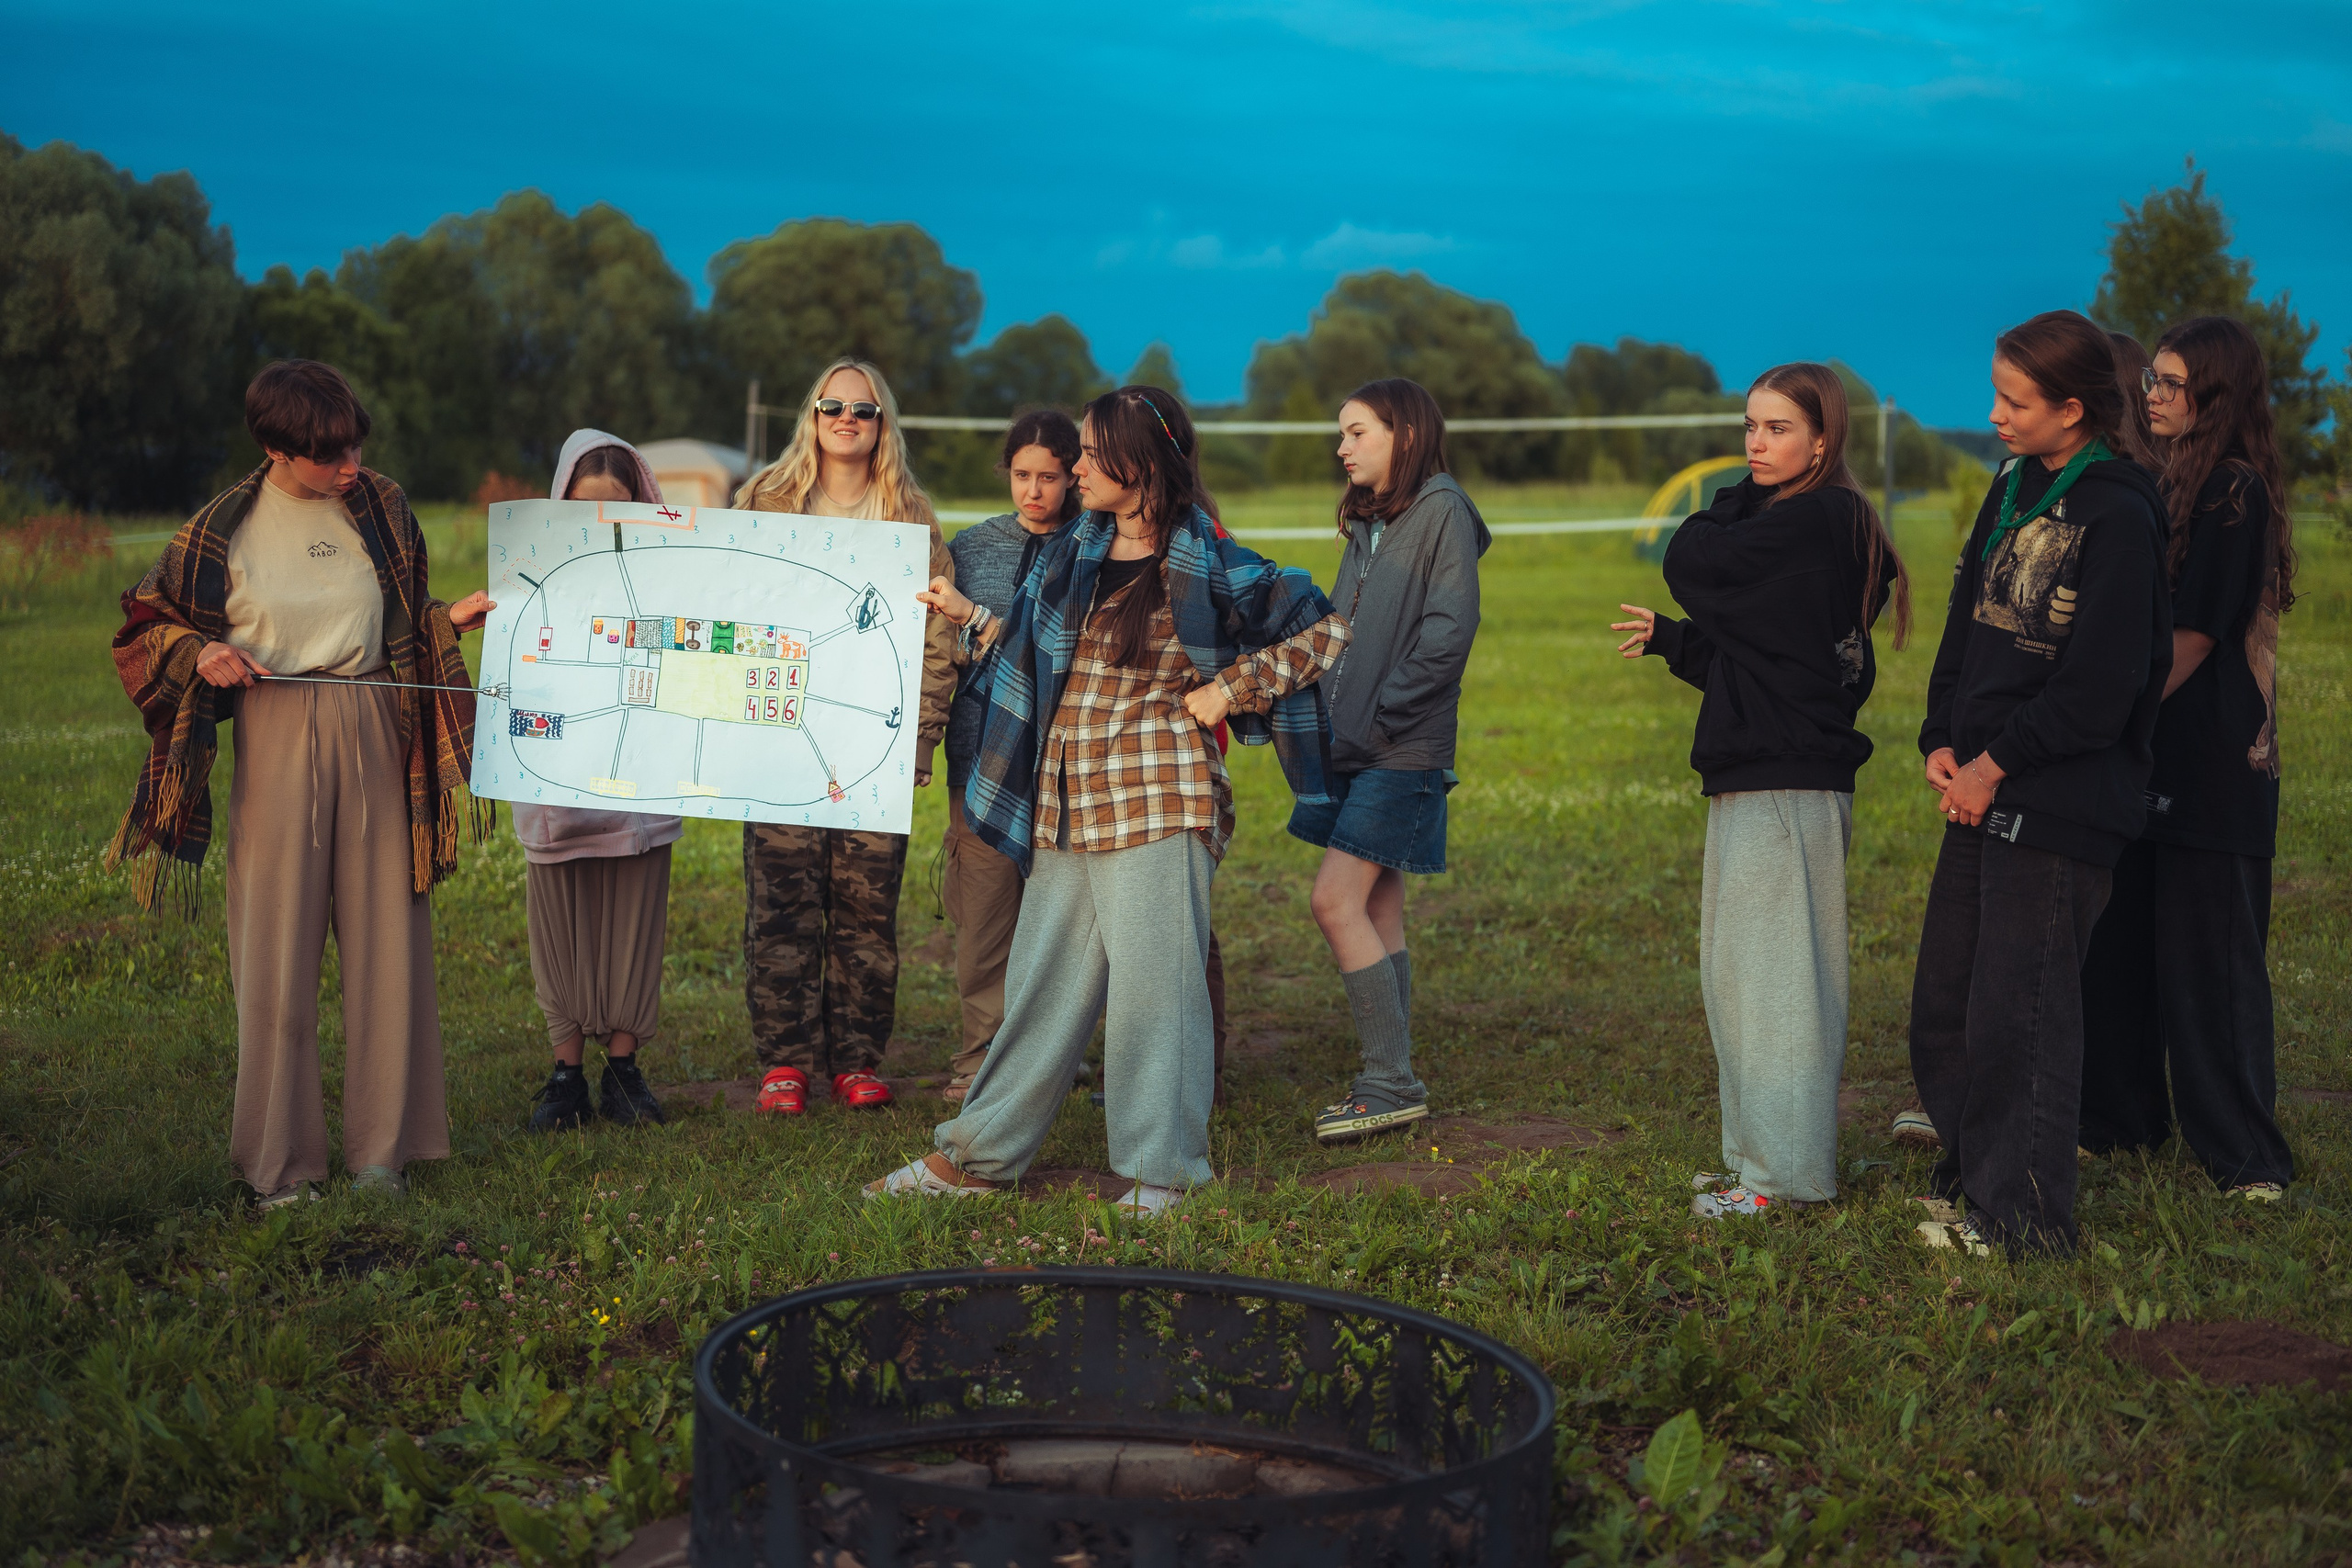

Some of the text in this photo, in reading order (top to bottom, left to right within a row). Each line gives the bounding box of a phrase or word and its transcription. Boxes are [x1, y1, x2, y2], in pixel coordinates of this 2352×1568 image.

[311, 549, 337, 558] ФАВОР
[748, 668, 798, 687] 3 2 1
[747, 698, 796, 721] 4 5 6
[1351, 1113, 1395, 1130] crocs
